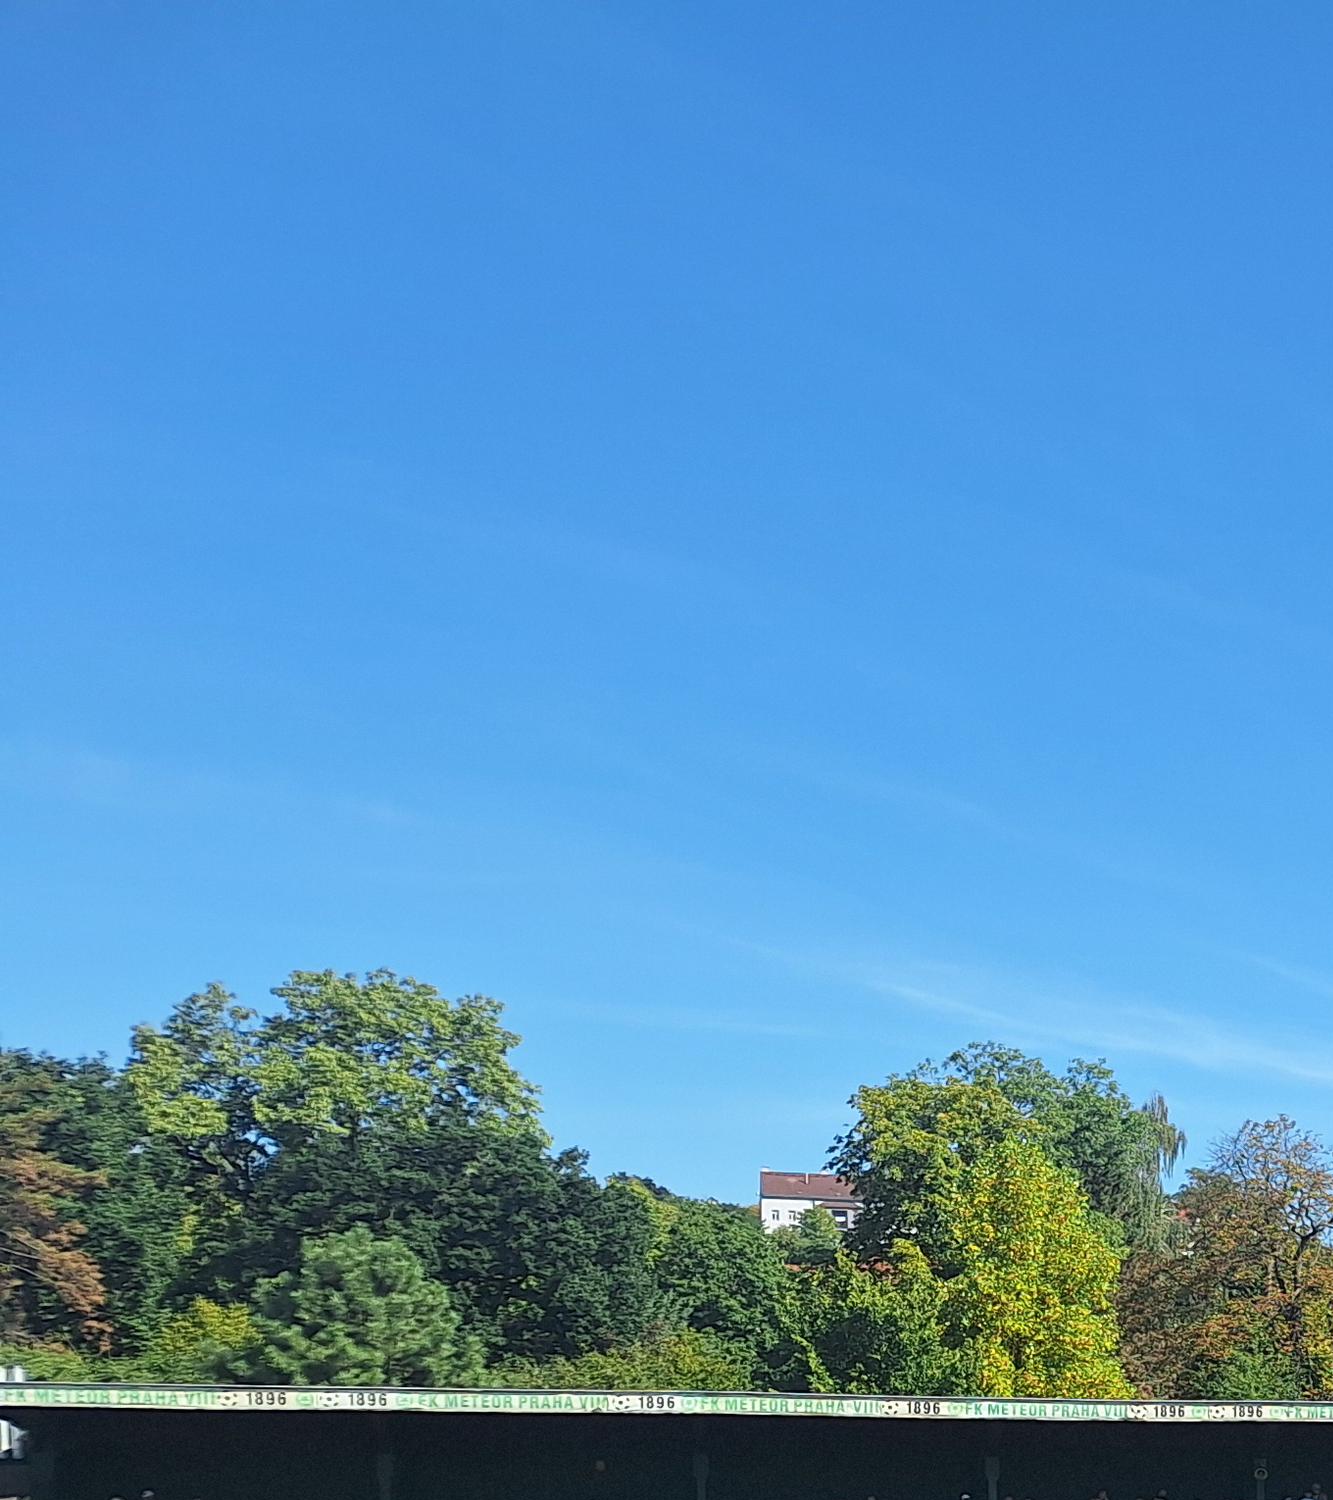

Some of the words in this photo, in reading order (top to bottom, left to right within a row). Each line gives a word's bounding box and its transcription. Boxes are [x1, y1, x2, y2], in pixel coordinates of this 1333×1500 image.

[34, 1391, 110, 1404] METEOR
[117, 1392, 179, 1405] PRAHA
[246, 1392, 287, 1405] 1896
[349, 1393, 387, 1406] 1896
[447, 1395, 513, 1408] METEOR
[519, 1396, 574, 1409] PRAHA
[638, 1396, 675, 1409] 1896
[701, 1398, 720, 1410] FK
[725, 1398, 788, 1412] METEOR
[794, 1400, 845, 1413] PRAHA
[906, 1401, 941, 1414] 1896
[965, 1404, 983, 1415] FK
[988, 1404, 1047, 1416] METEOR
[1052, 1405, 1099, 1417] PRAHA
[1153, 1405, 1185, 1417] 1896
[1232, 1406, 1263, 1418] 1896
